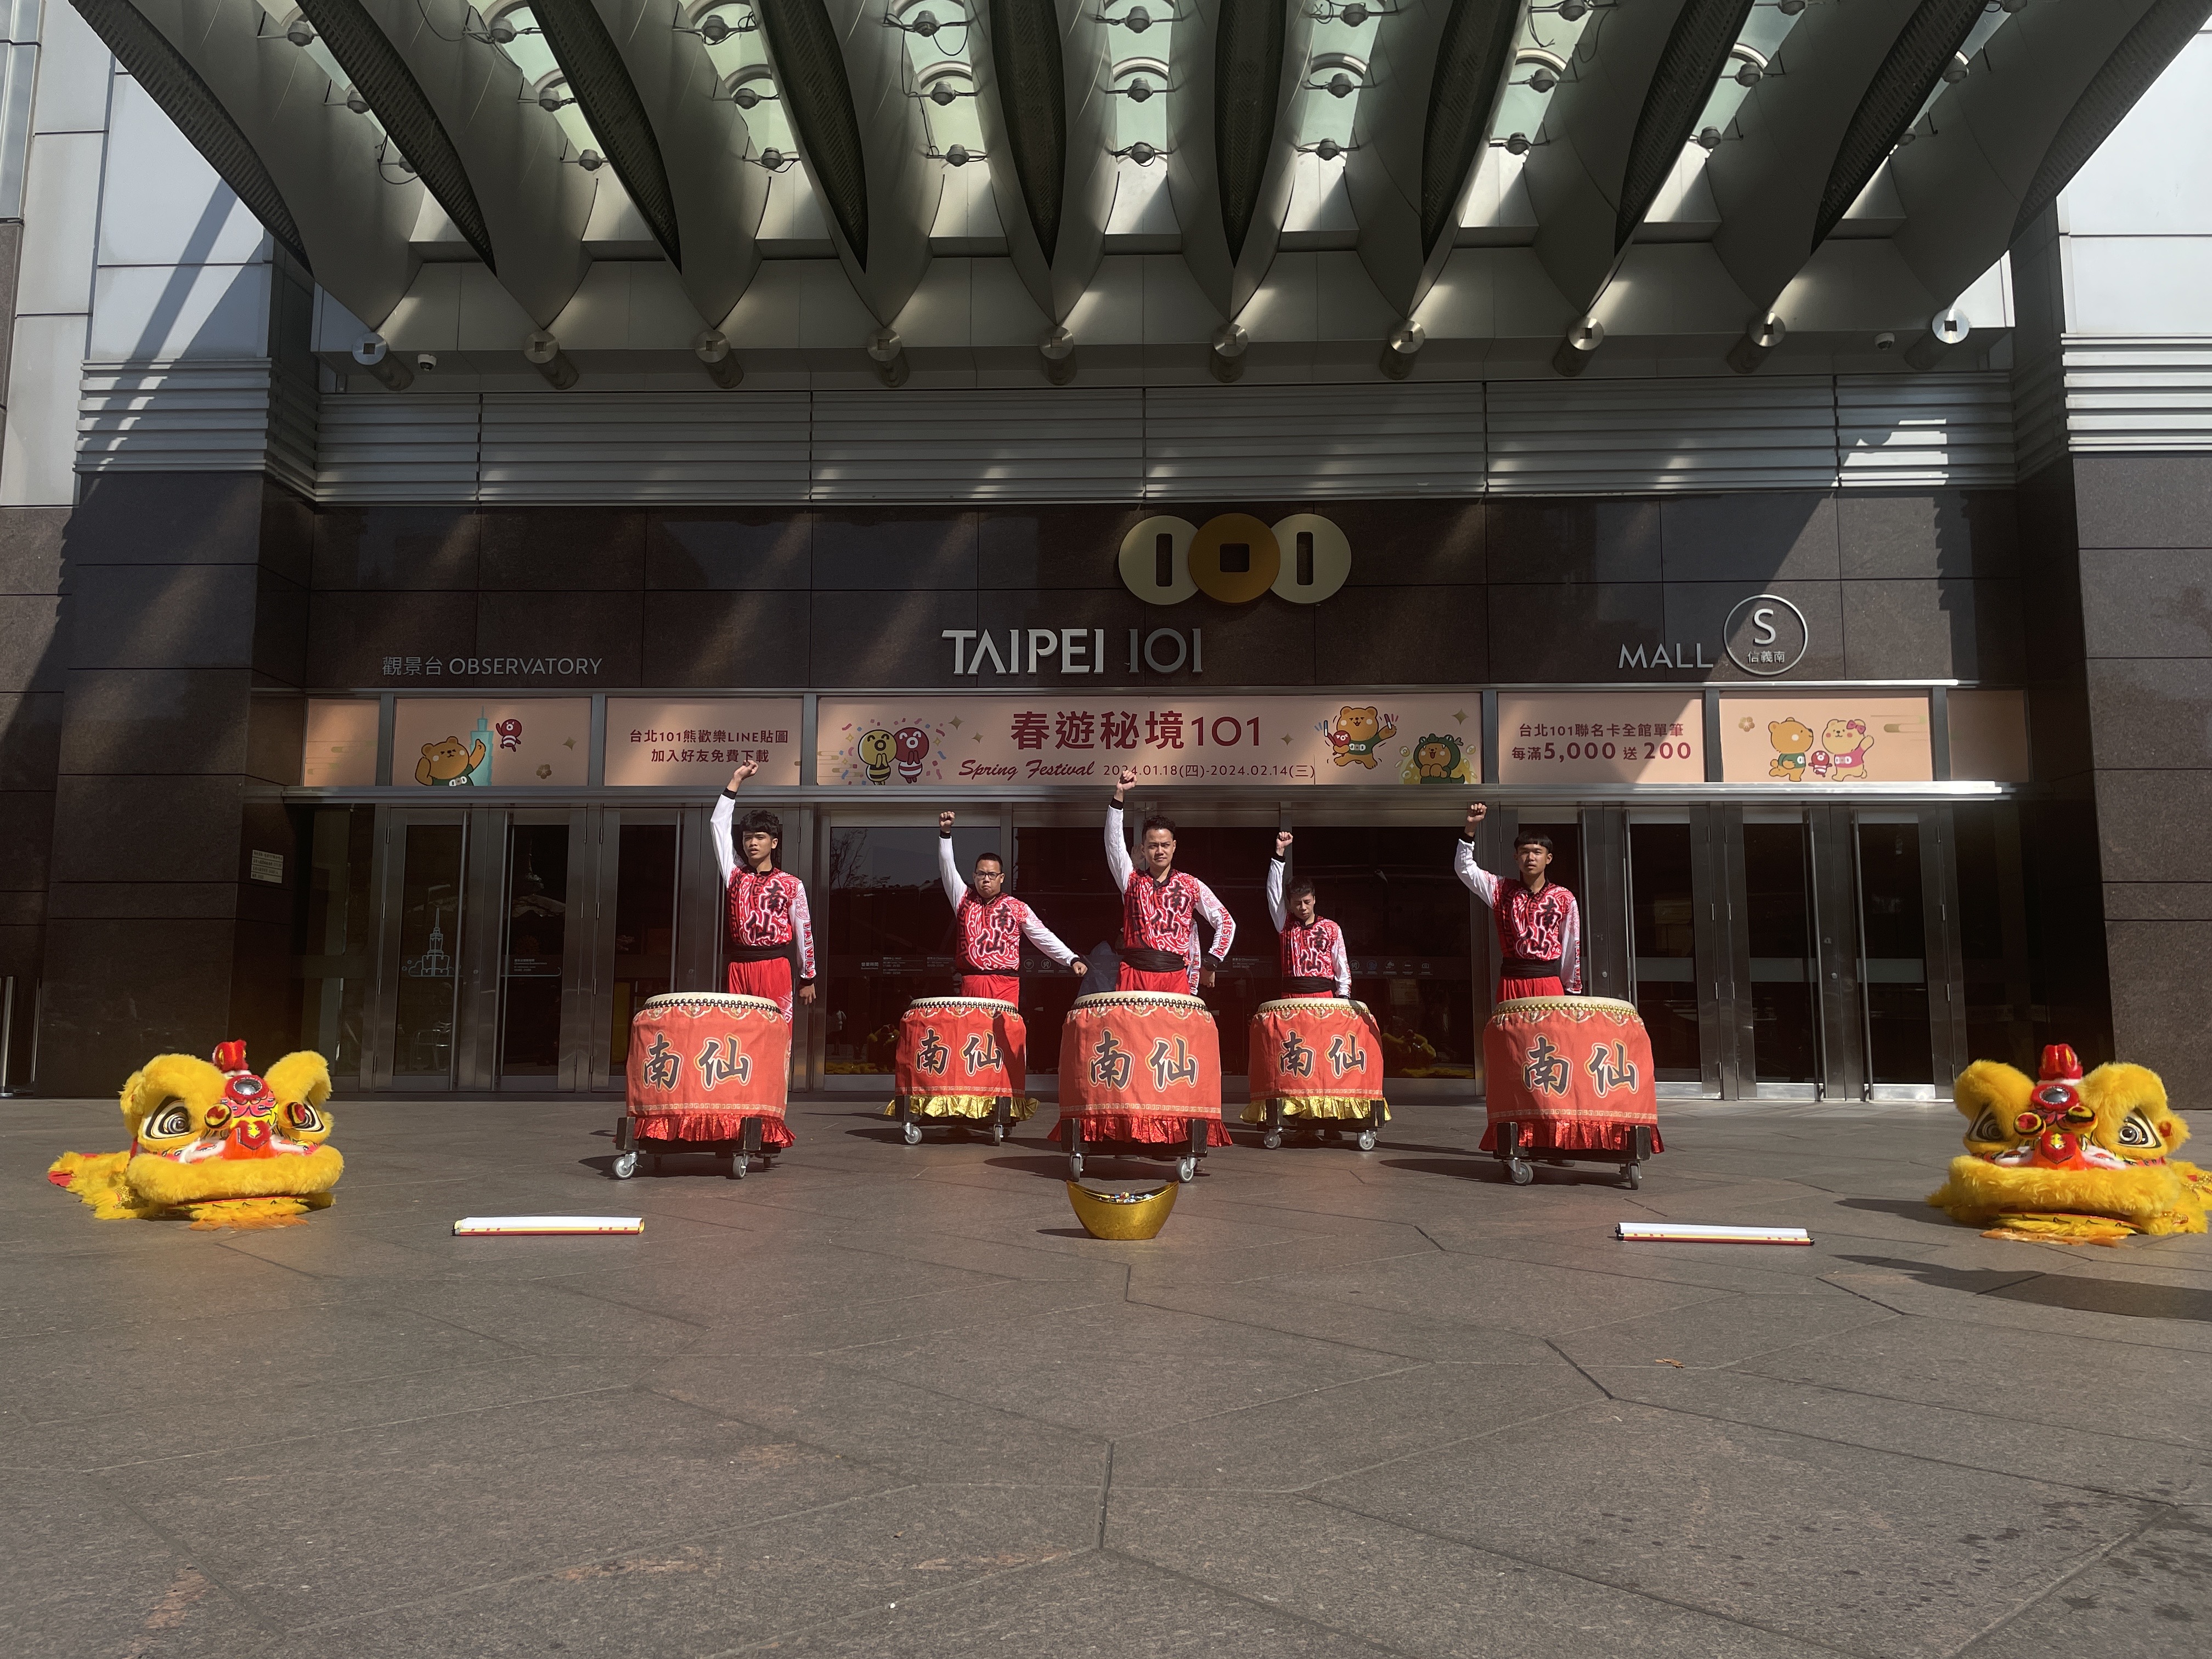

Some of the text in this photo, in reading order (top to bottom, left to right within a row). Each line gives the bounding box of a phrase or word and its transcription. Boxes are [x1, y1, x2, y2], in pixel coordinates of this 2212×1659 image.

[1754, 608, 1776, 645] S
[941, 629, 1104, 675] TAIPEI
[1618, 643, 1713, 668] MALL
[1748, 651, 1785, 663] 信義南
[382, 656, 602, 676] 觀景台 OBSERVATORY
[630, 729, 788, 744] 台北101熊歡樂LINE貼圖
[1011, 710, 1260, 750] 春遊秘境101
[1519, 723, 1684, 737] 台北101聯名卡全館單筆
[651, 749, 769, 763] 加入好友免費下載
[1511, 742, 1691, 763] 每滿5,000 送 200
[958, 759, 1096, 781] Spring Festival
